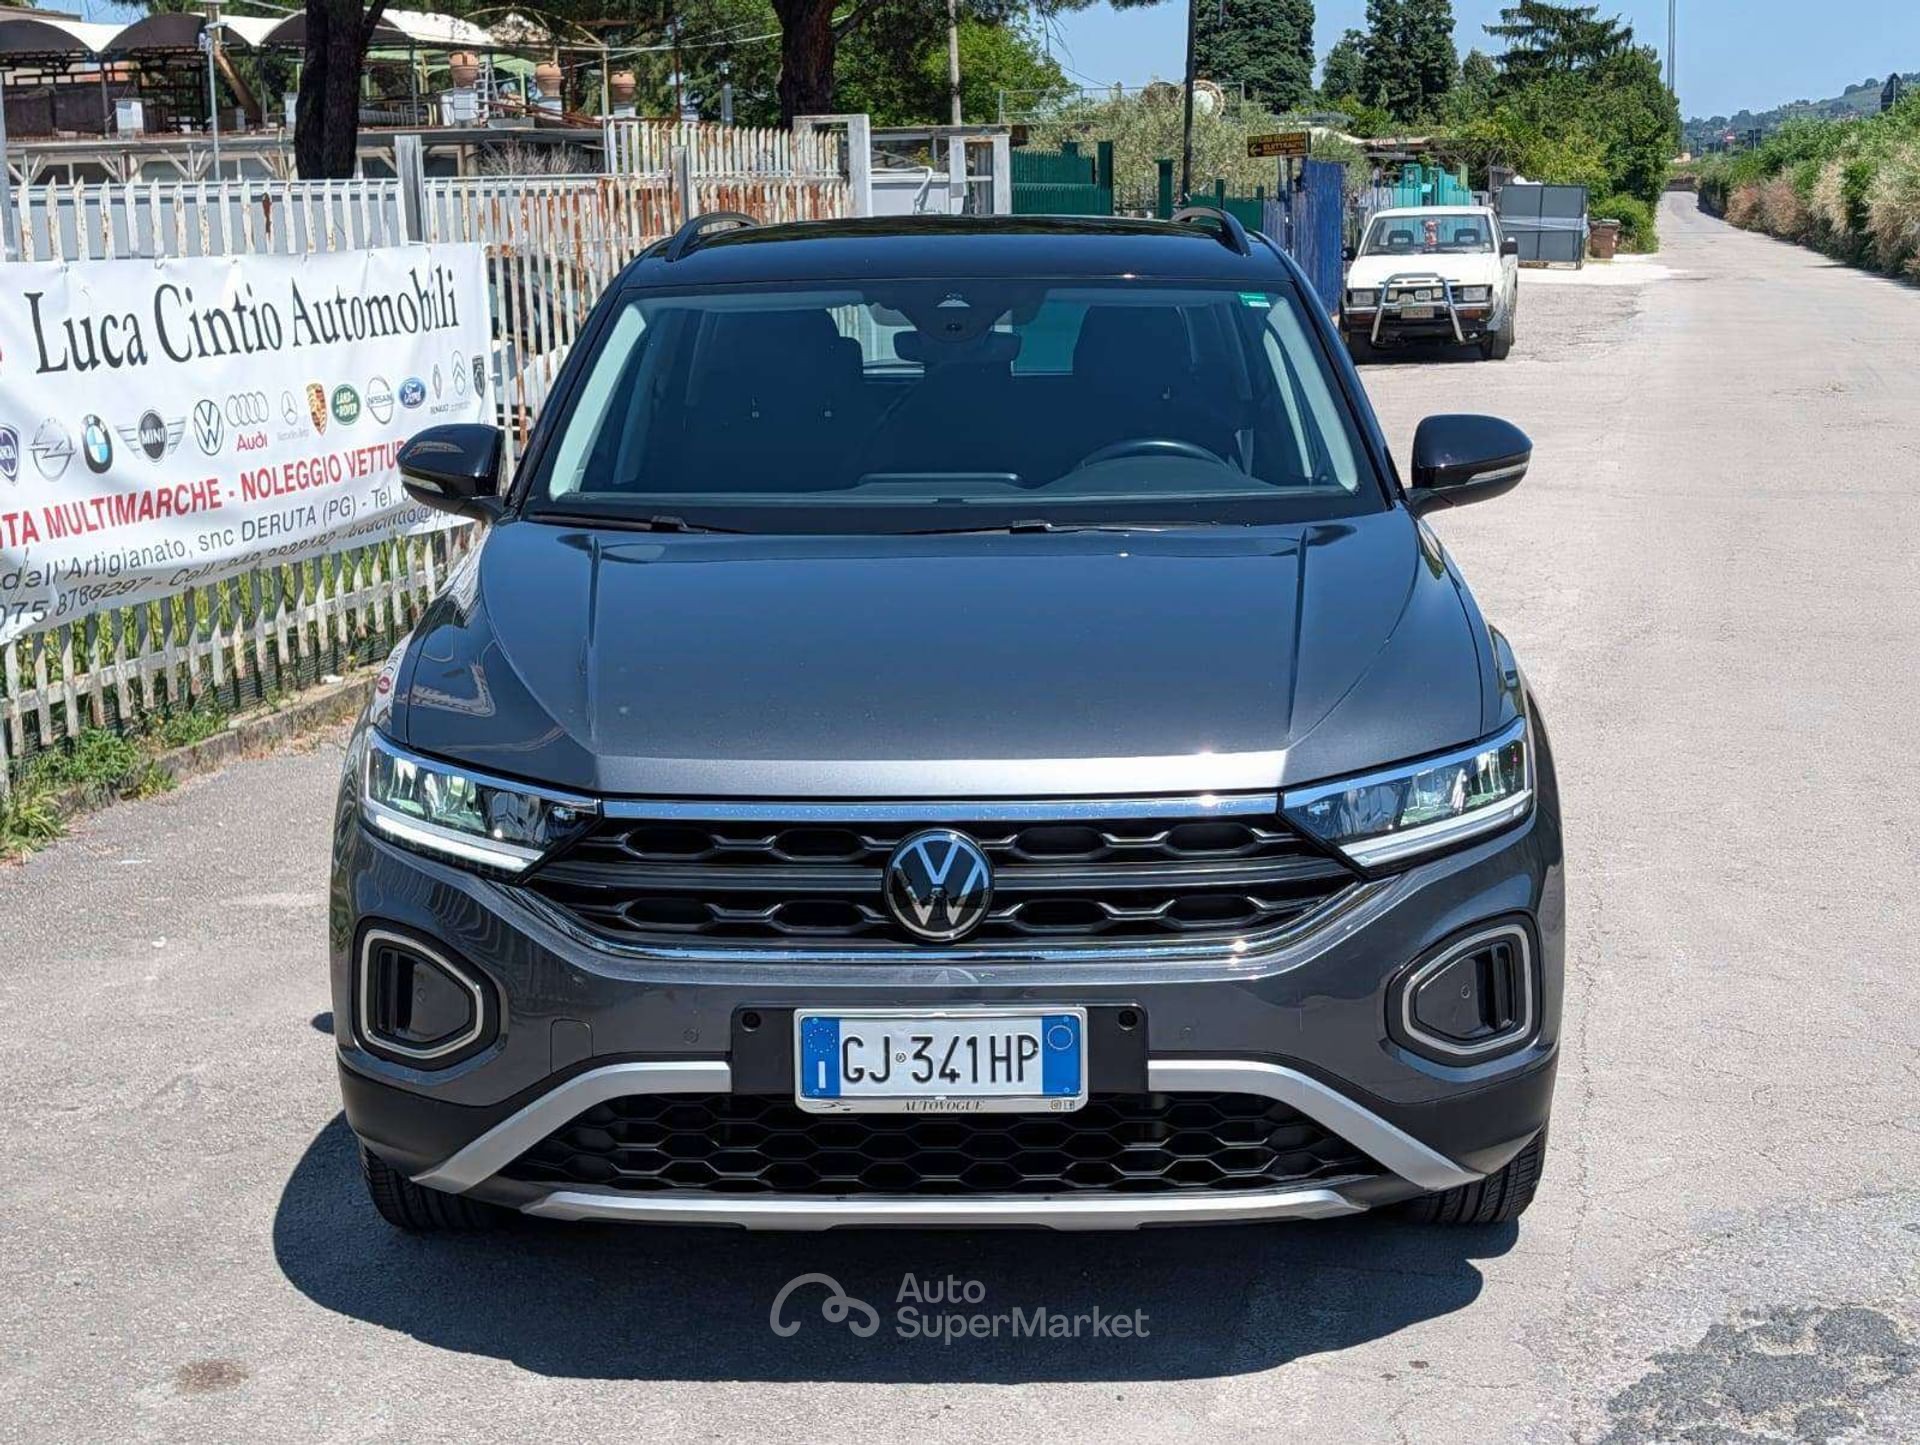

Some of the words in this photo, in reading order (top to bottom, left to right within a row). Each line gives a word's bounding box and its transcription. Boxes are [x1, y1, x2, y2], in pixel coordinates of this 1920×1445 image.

[24, 291, 148, 374] Luca
[154, 281, 283, 363] Cintio
[291, 264, 459, 347] Automobili
[140, 429, 166, 446] MINI
[236, 432, 268, 452] Audi
[43, 478, 223, 540] MULTIMARCHE
[240, 454, 342, 501] NOLEGGIO
[198, 528, 235, 552] snc
[241, 505, 317, 542] DERUTA
[323, 494, 356, 526] (PG)
[370, 486, 397, 509] Tel.
[842, 1035, 891, 1084] GJ
[910, 1034, 1039, 1084] 341HP
[902, 1100, 985, 1112] AUTOVOGUE
